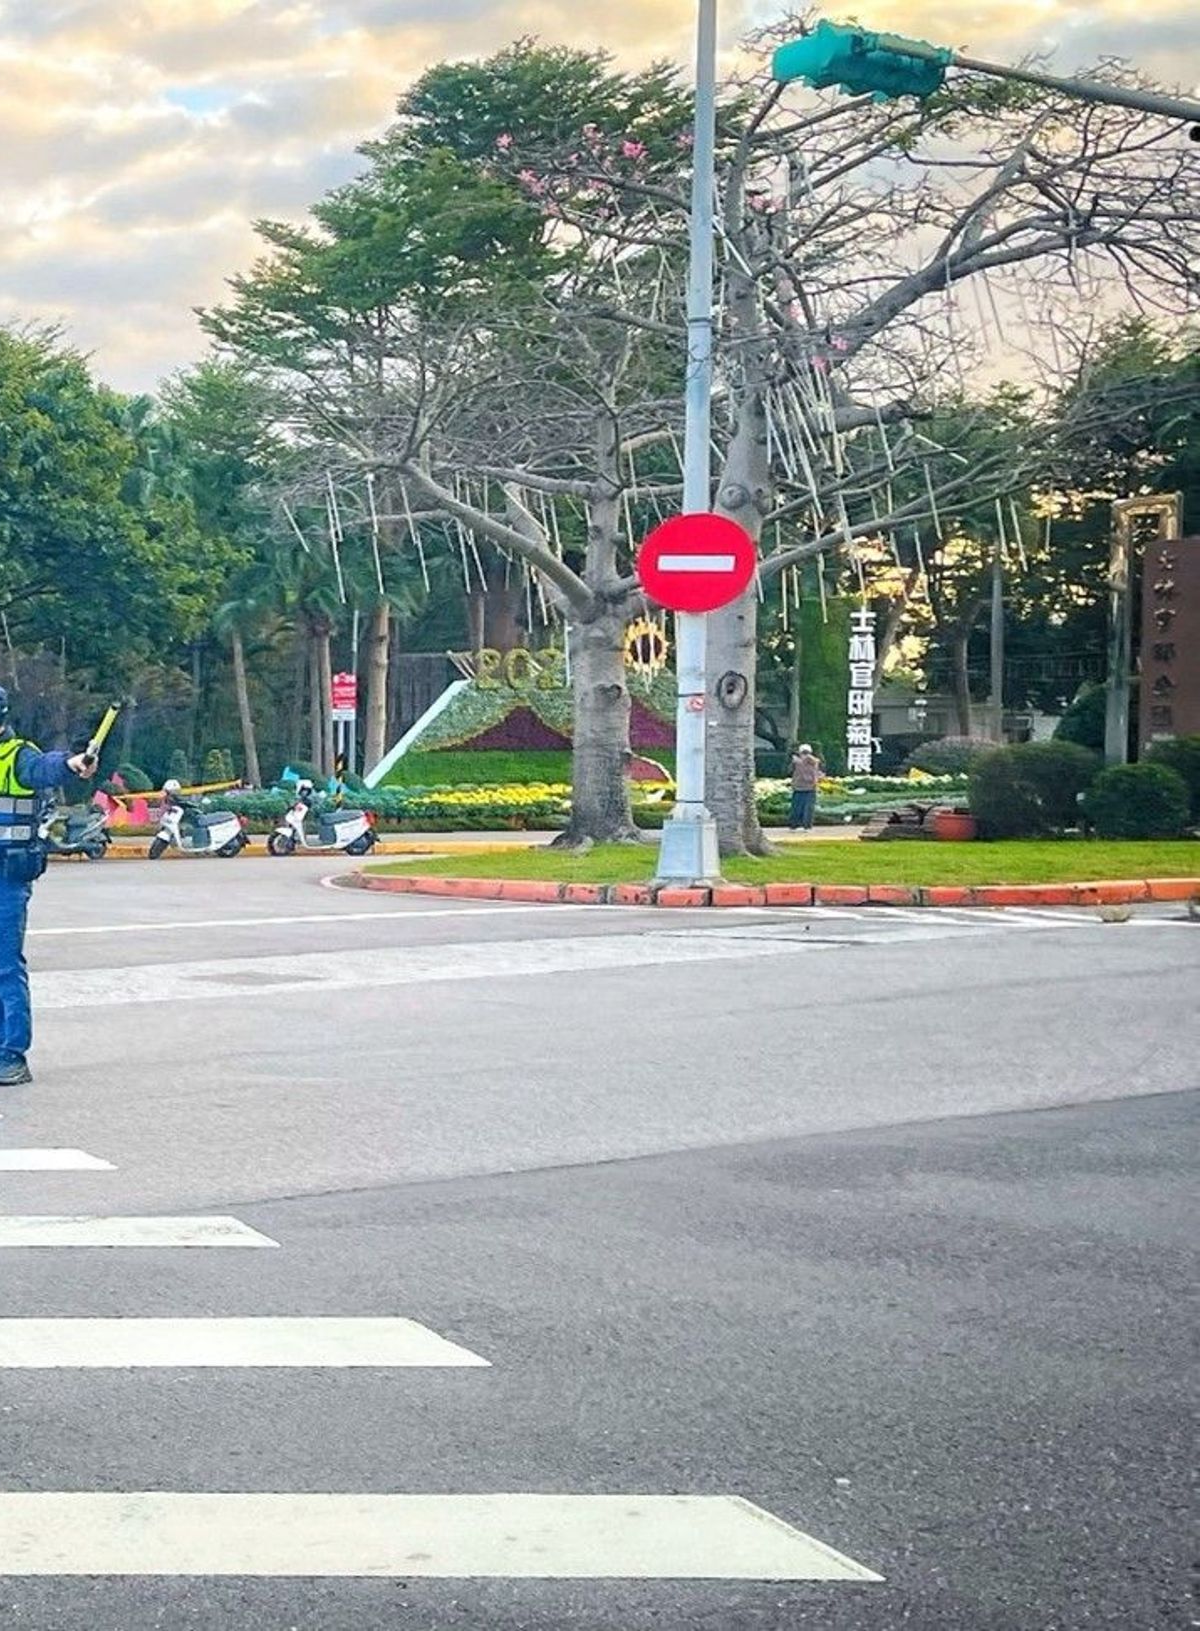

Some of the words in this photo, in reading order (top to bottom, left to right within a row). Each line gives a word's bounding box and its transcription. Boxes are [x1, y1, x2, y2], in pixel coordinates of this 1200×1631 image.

[846, 606, 877, 772] 士林官邸菊展
